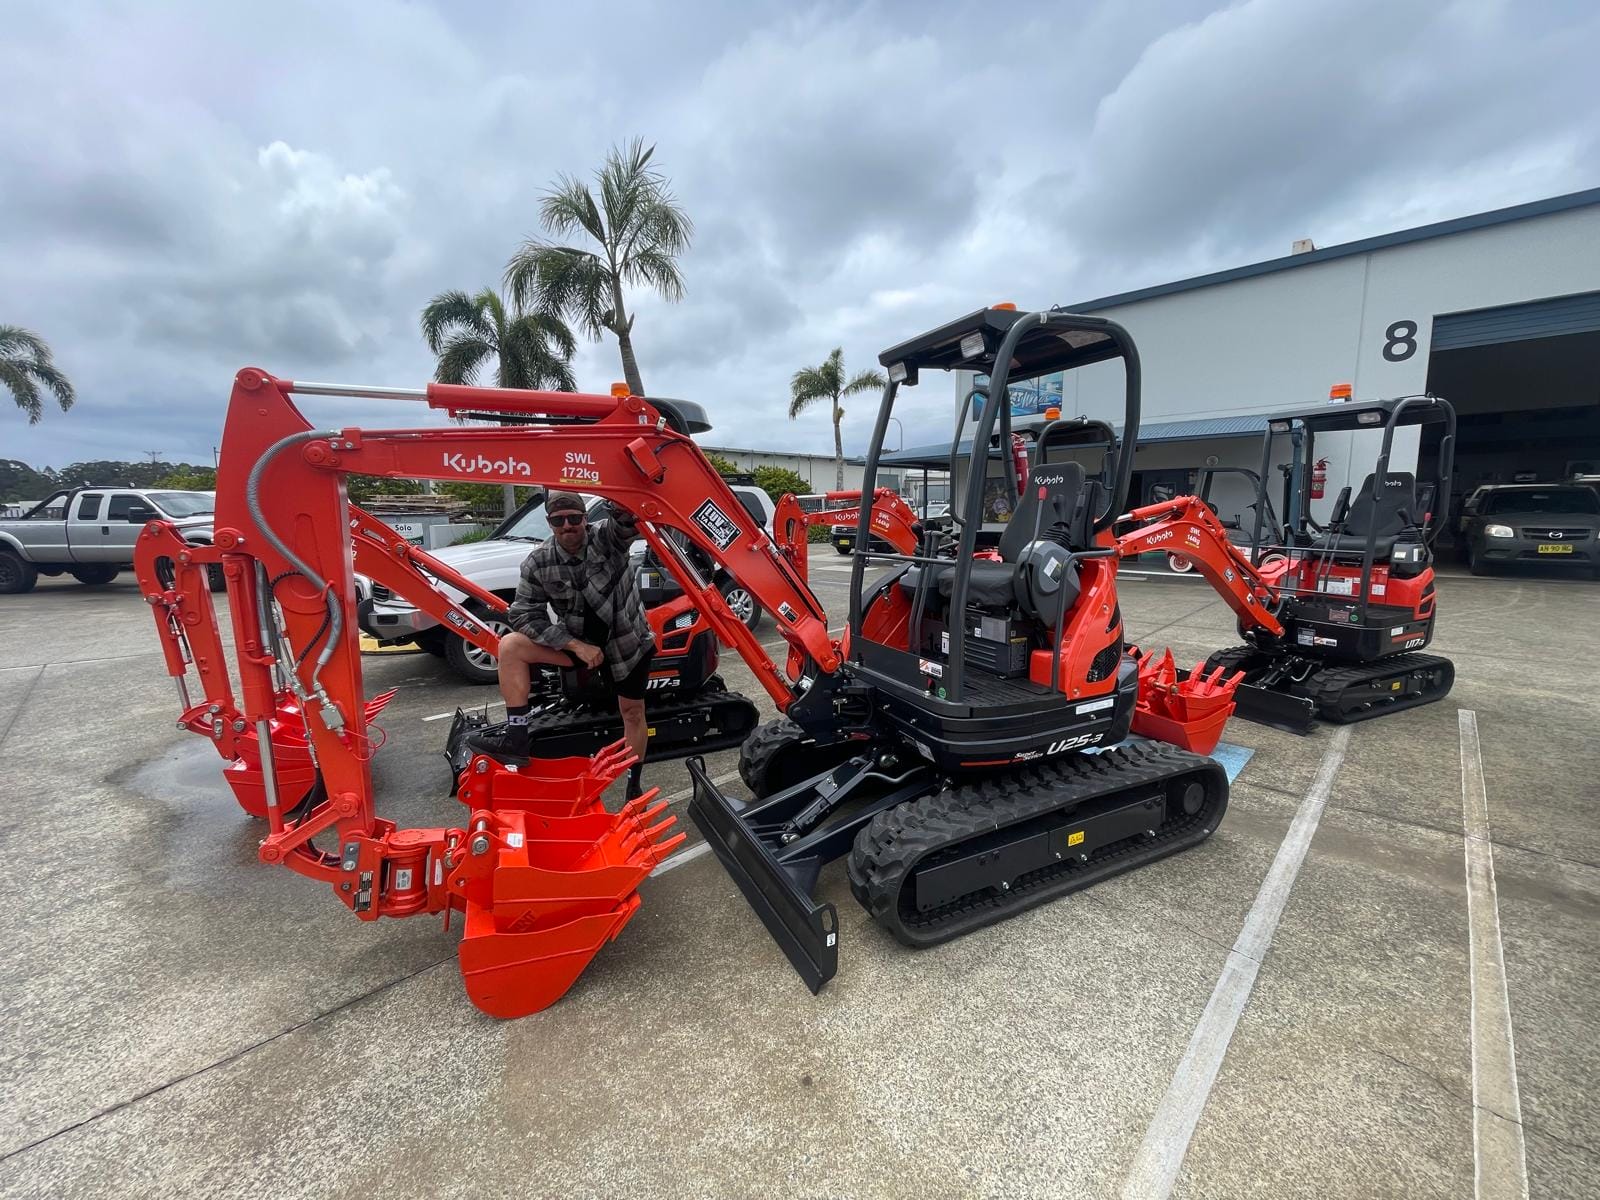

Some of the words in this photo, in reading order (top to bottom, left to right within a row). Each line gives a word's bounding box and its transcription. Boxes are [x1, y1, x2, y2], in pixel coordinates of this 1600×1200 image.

[1382, 320, 1418, 362] 8
[443, 452, 531, 476] Kubota
[565, 452, 595, 465] SWL
[561, 466, 599, 481] 172kg
[1034, 474, 1064, 485] Kubota
[704, 507, 725, 527] LUV
[834, 511, 861, 522] Kubot
[1146, 530, 1173, 545] Kubota
[1047, 733, 1104, 755] U25-3
